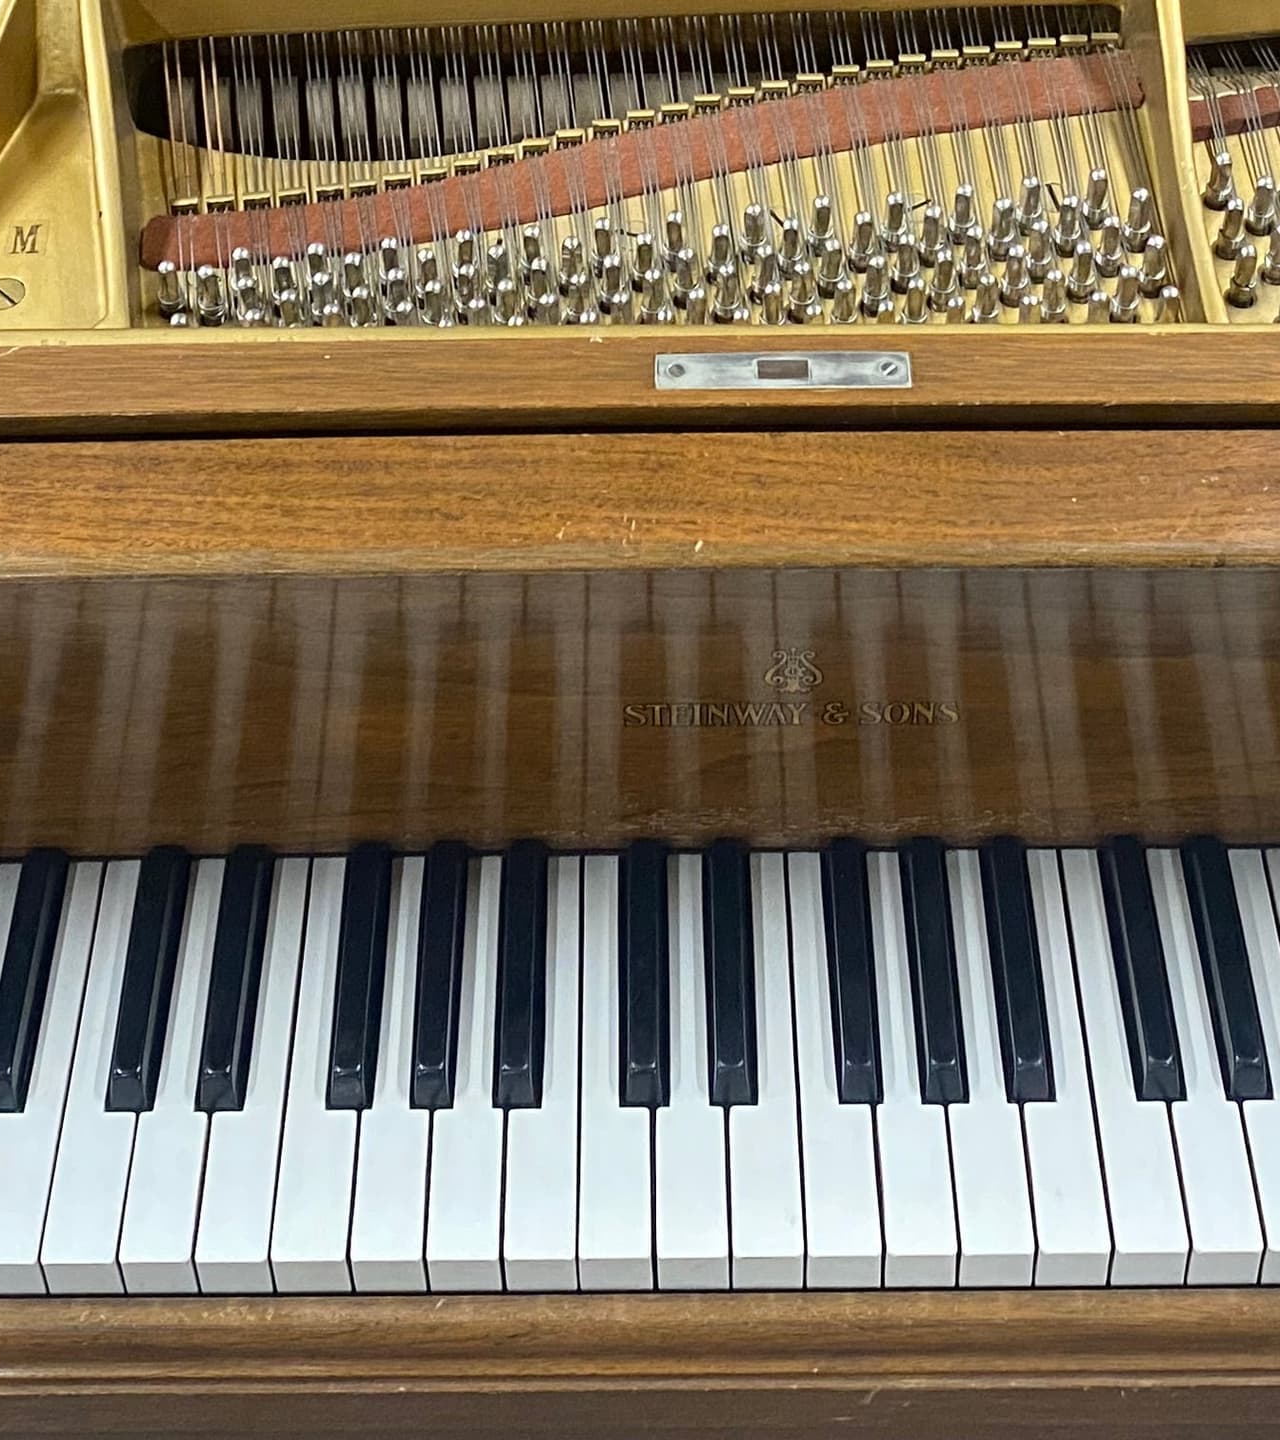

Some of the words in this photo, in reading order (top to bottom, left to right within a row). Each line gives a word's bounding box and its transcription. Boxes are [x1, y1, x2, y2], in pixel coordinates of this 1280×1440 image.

[8, 223, 43, 255] M
[622, 702, 808, 728] STEINWAY
[821, 701, 849, 725] &
[858, 700, 961, 727] SONS
